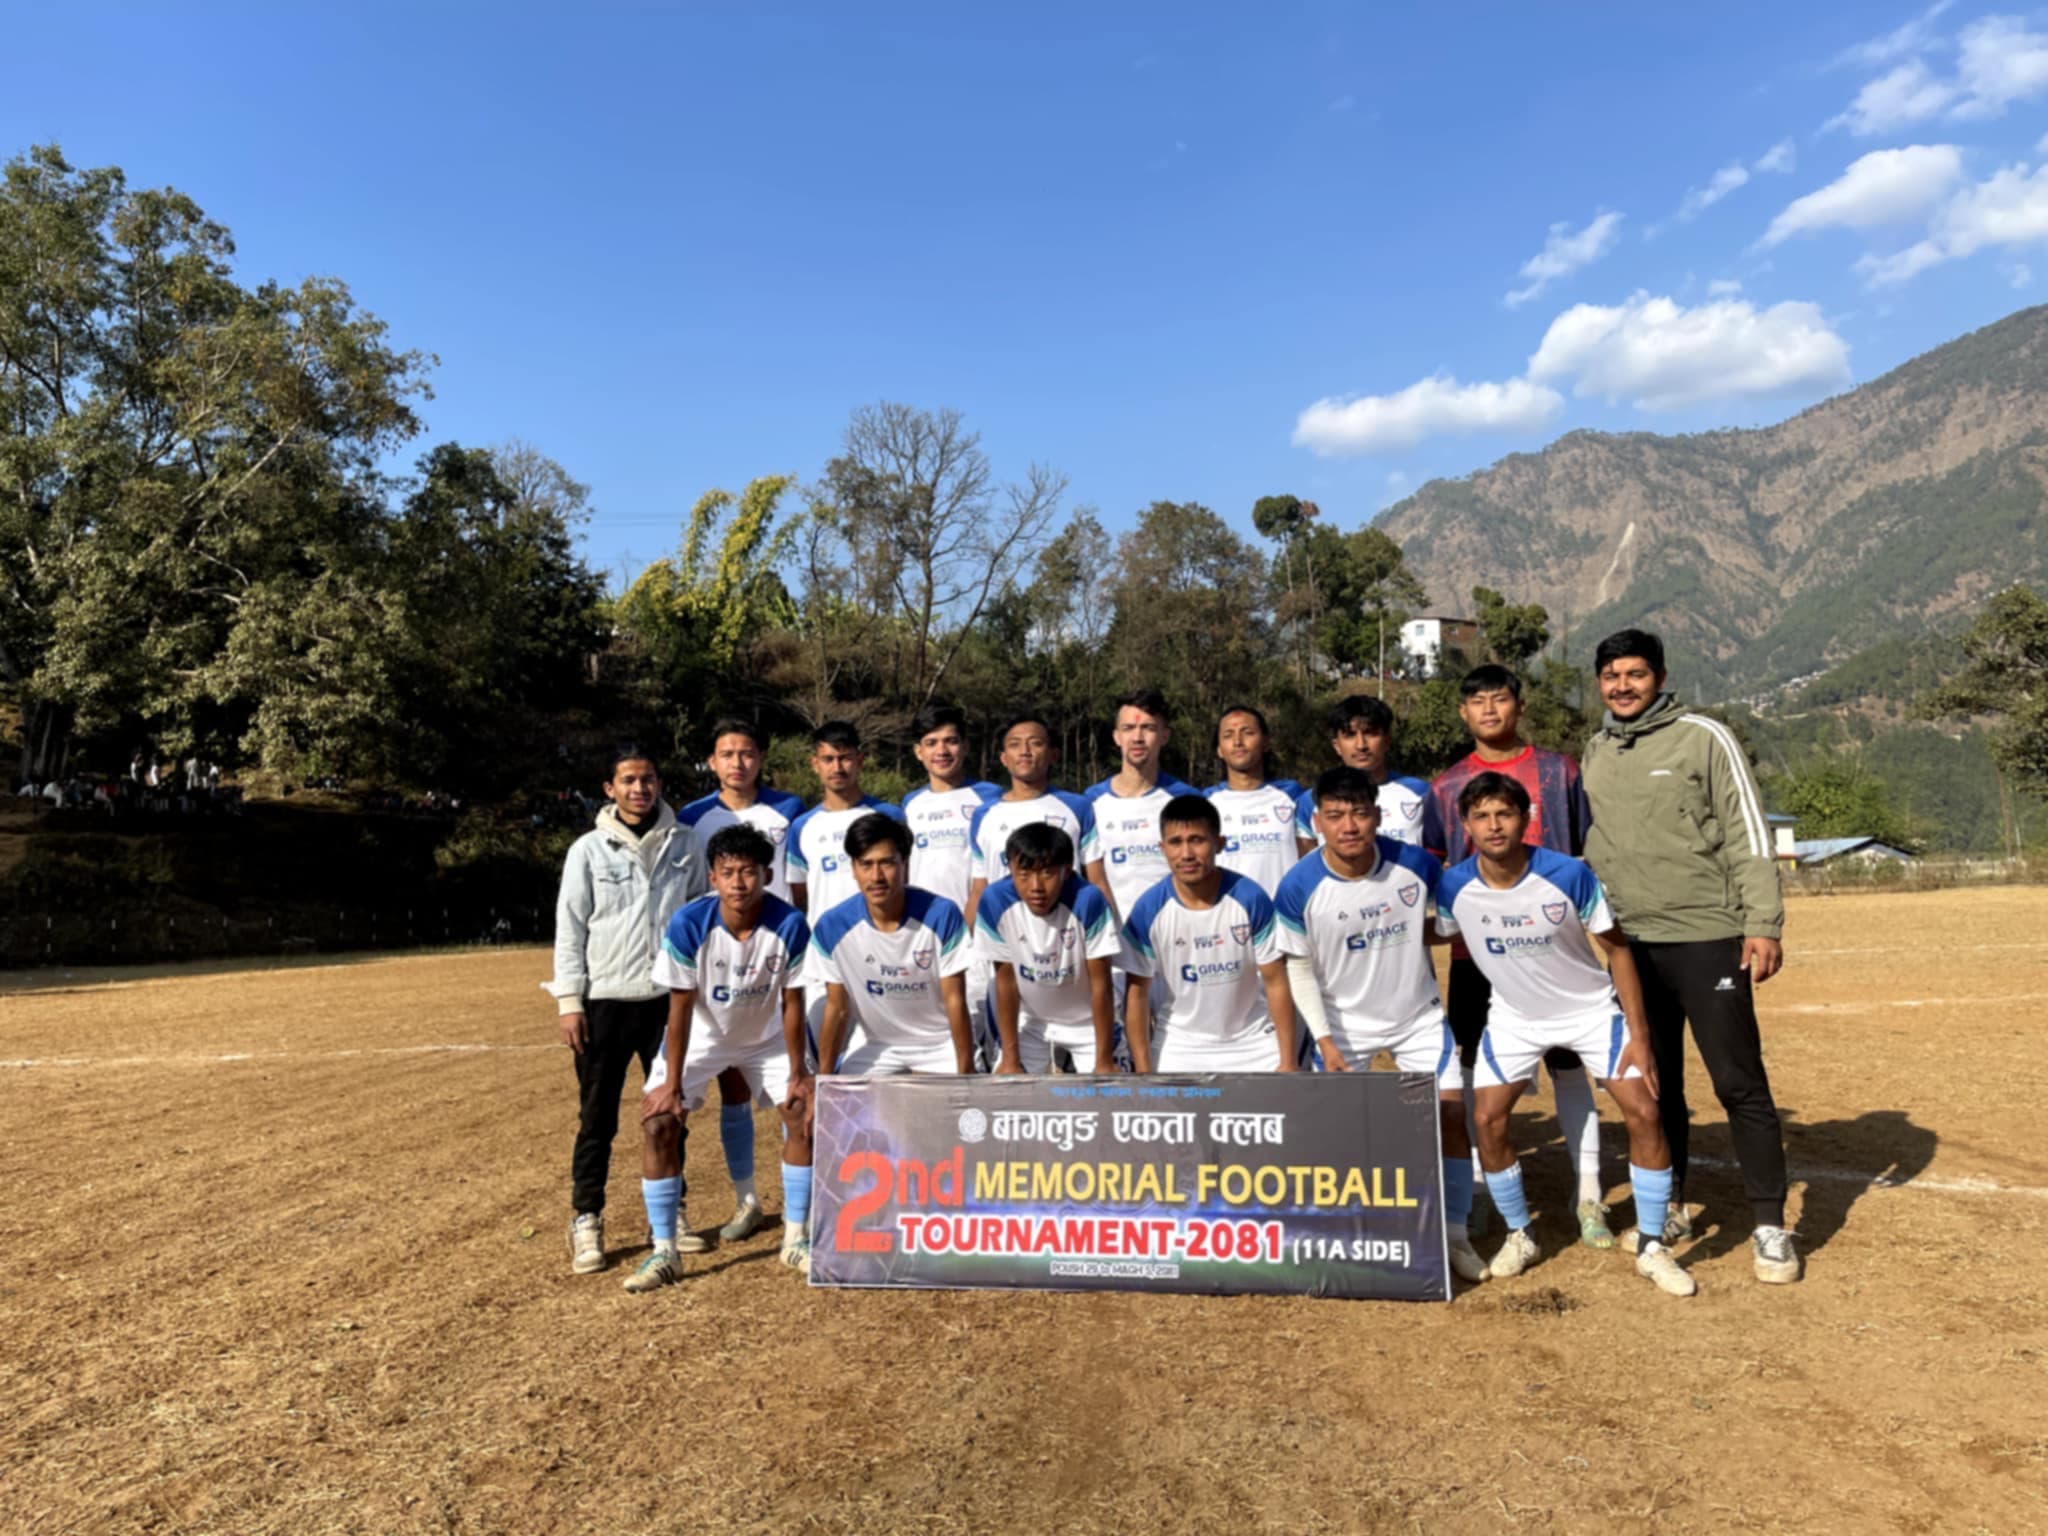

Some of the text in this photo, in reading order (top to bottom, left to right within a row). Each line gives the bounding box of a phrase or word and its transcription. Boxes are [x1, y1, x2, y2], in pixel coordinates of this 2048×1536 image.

[1241, 832, 1281, 843] GRACE
[1127, 844, 1160, 855] GRAC
[1366, 922, 1408, 940] GRACE
[1505, 934, 1553, 947] GRACE
[1199, 960, 1242, 975] GRACE
[885, 982, 929, 992] GRACE
[992, 1111, 1285, 1151] बागलुङ एकता क्लब
[835, 1145, 1418, 1253] 2nd MEMORIAL FOOTBALL
[900, 1216, 1281, 1260] TOURNAMENT-2081
[1351, 1241, 1411, 1267] SIDE)
